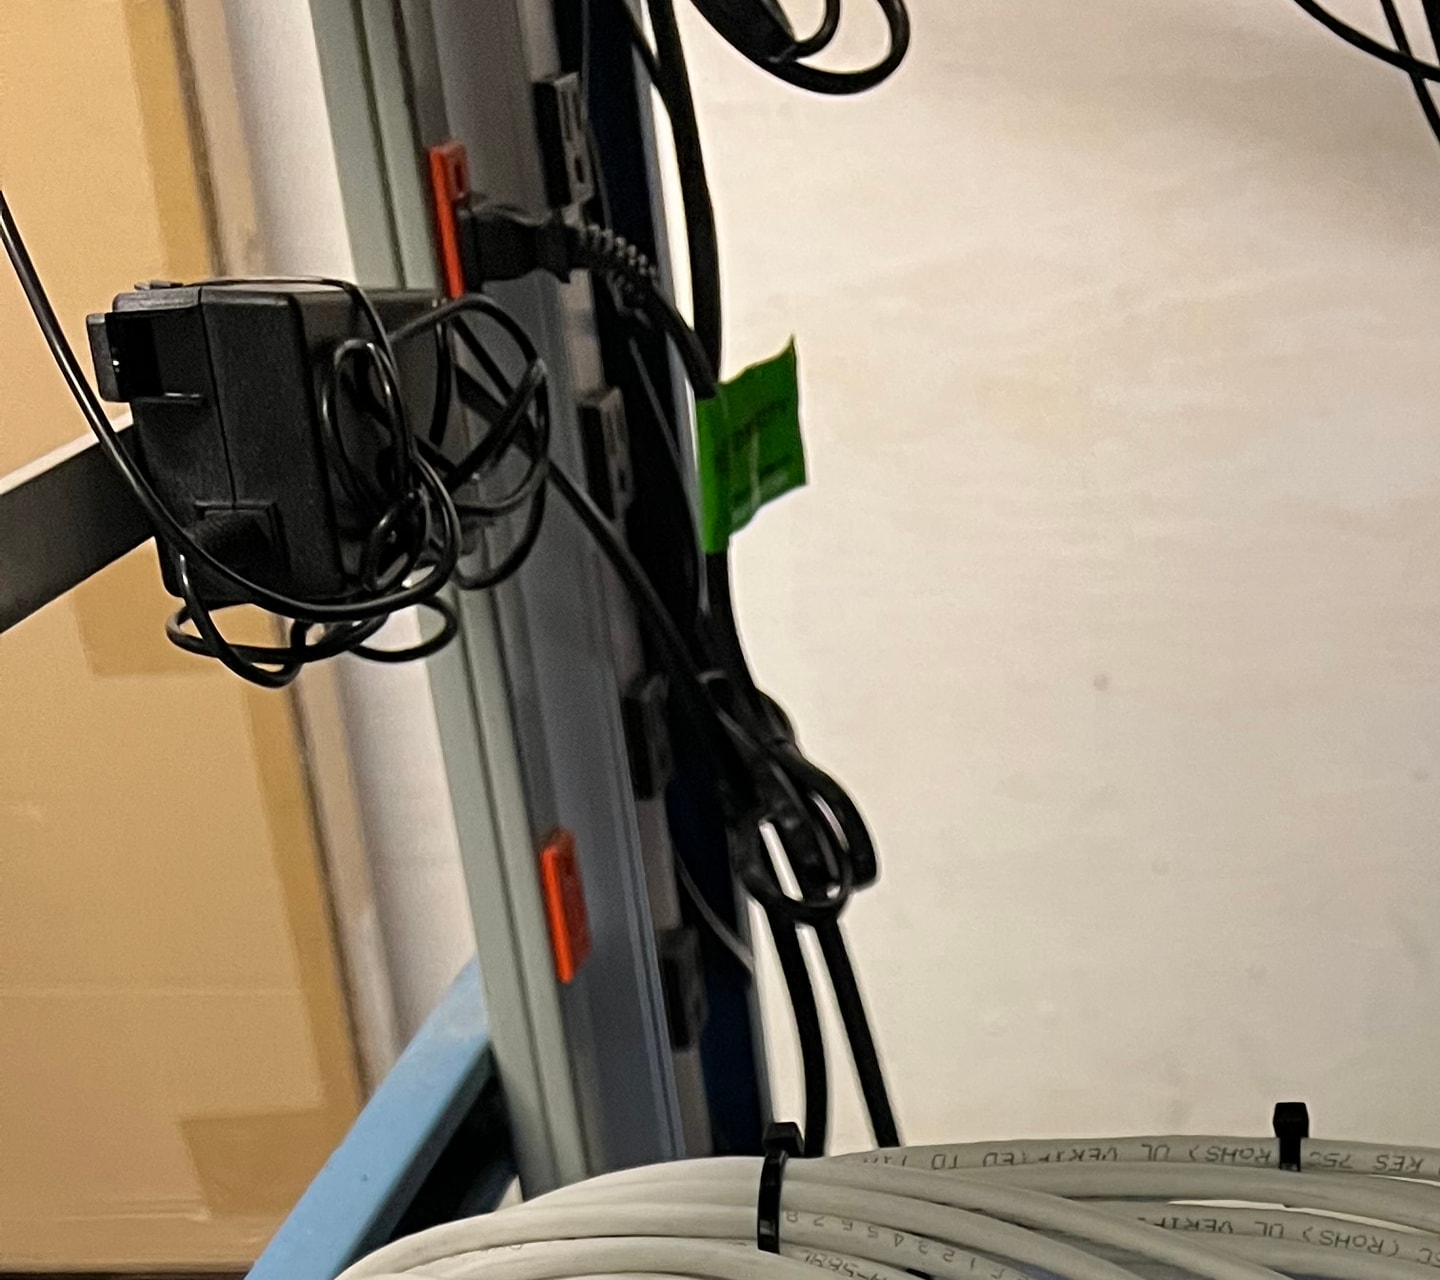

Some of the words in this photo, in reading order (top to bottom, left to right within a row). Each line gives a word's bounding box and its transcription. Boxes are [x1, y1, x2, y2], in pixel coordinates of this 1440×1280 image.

[1140, 1143, 1172, 1163] UL
[1373, 1153, 1425, 1174] RES
[866, 1225, 880, 1240] 5
[1252, 1219, 1286, 1240] UL
[893, 1232, 905, 1248] 4
[1300, 1226, 1401, 1258] (RoHS)
[941, 1248, 958, 1264] 2
